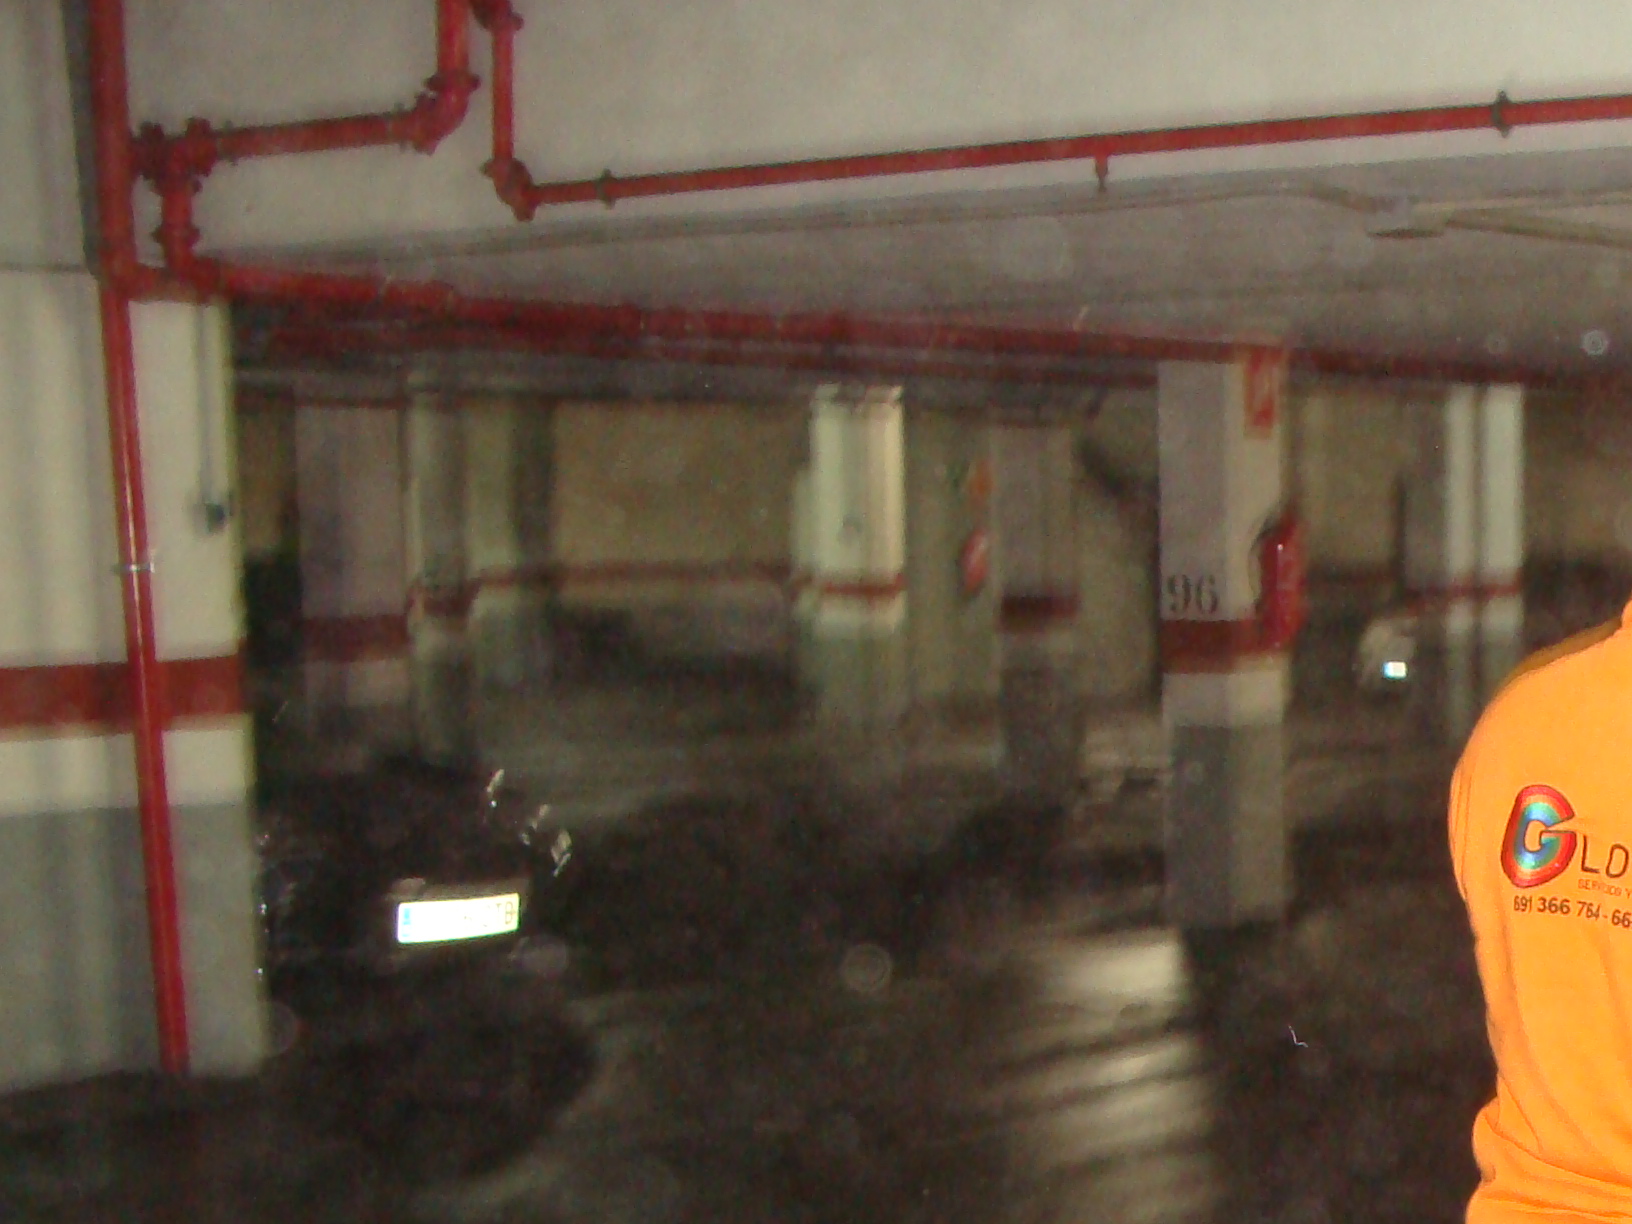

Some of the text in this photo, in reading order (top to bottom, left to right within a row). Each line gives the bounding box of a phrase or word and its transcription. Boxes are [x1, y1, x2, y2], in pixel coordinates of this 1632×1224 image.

[1167, 574, 1219, 613] 96
[1513, 895, 1533, 913] 691
[1536, 896, 1571, 915] 366
[1576, 900, 1601, 921] 764
